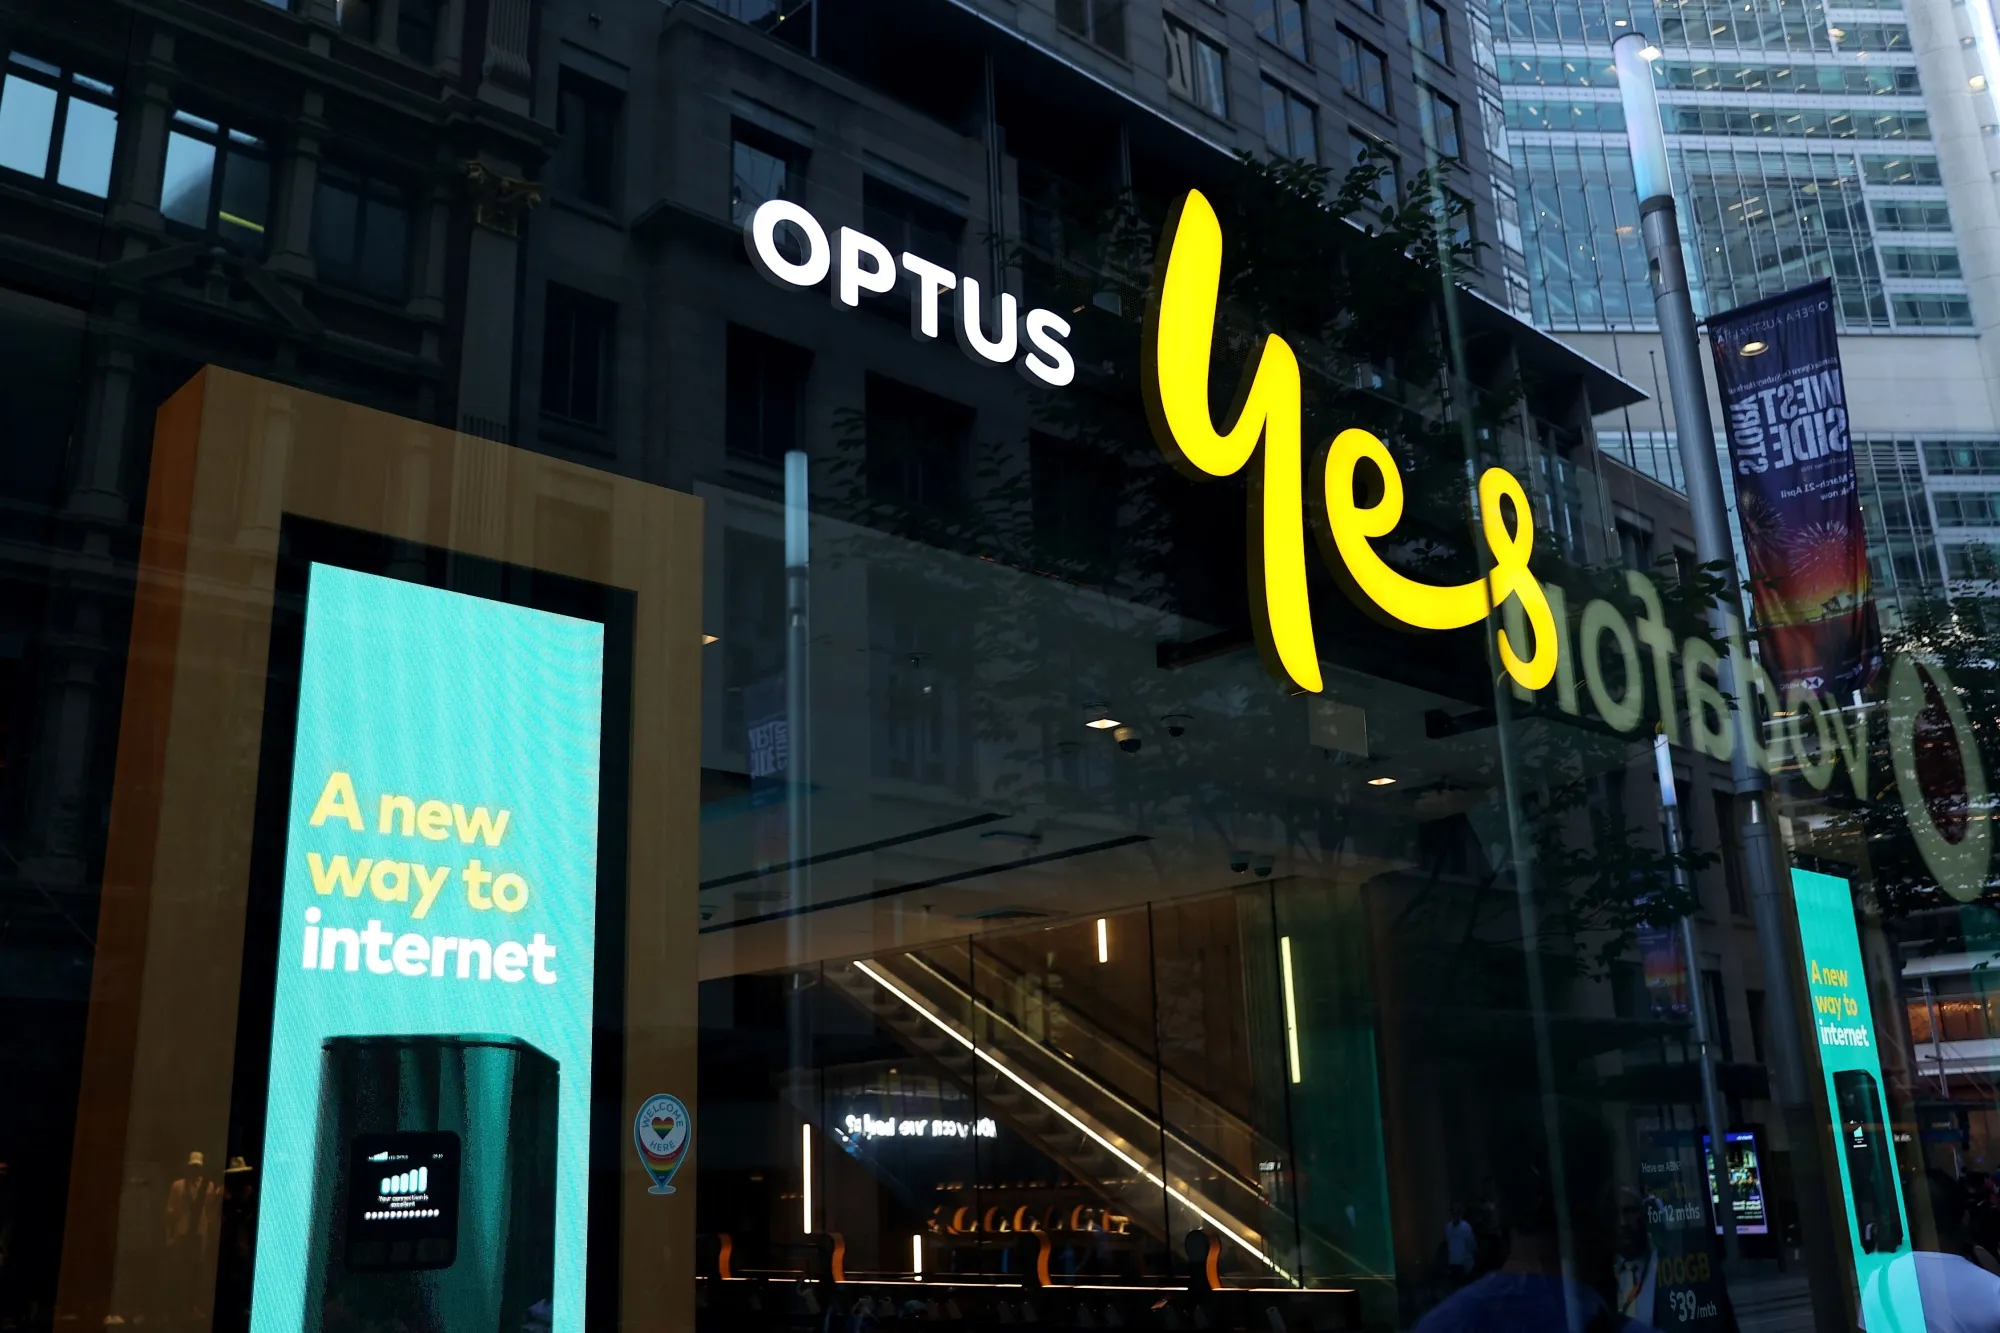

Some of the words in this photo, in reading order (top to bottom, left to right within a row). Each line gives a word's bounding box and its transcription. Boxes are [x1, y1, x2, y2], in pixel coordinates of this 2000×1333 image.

[752, 199, 1075, 386] OPTUS
[309, 772, 364, 831] A
[378, 793, 511, 847] new
[306, 852, 452, 919] way
[462, 858, 529, 913] to
[302, 906, 558, 985] internet
[1811, 960, 1823, 984] A
[1822, 967, 1848, 987] new
[1815, 996, 1841, 1021] way
[1843, 993, 1858, 1016] to
[1819, 1018, 1870, 1047] internet
[642, 1102, 684, 1128] WELCOME
[649, 1140, 676, 1152] HERE
[1641, 1162, 1657, 1173] Have
[1657, 1163, 1665, 1172] an
[1647, 1206, 1662, 1224] for
[1664, 1204, 1675, 1222] 12
[1675, 1202, 1701, 1221] mths
[1658, 1252, 1711, 1289] 100GB
